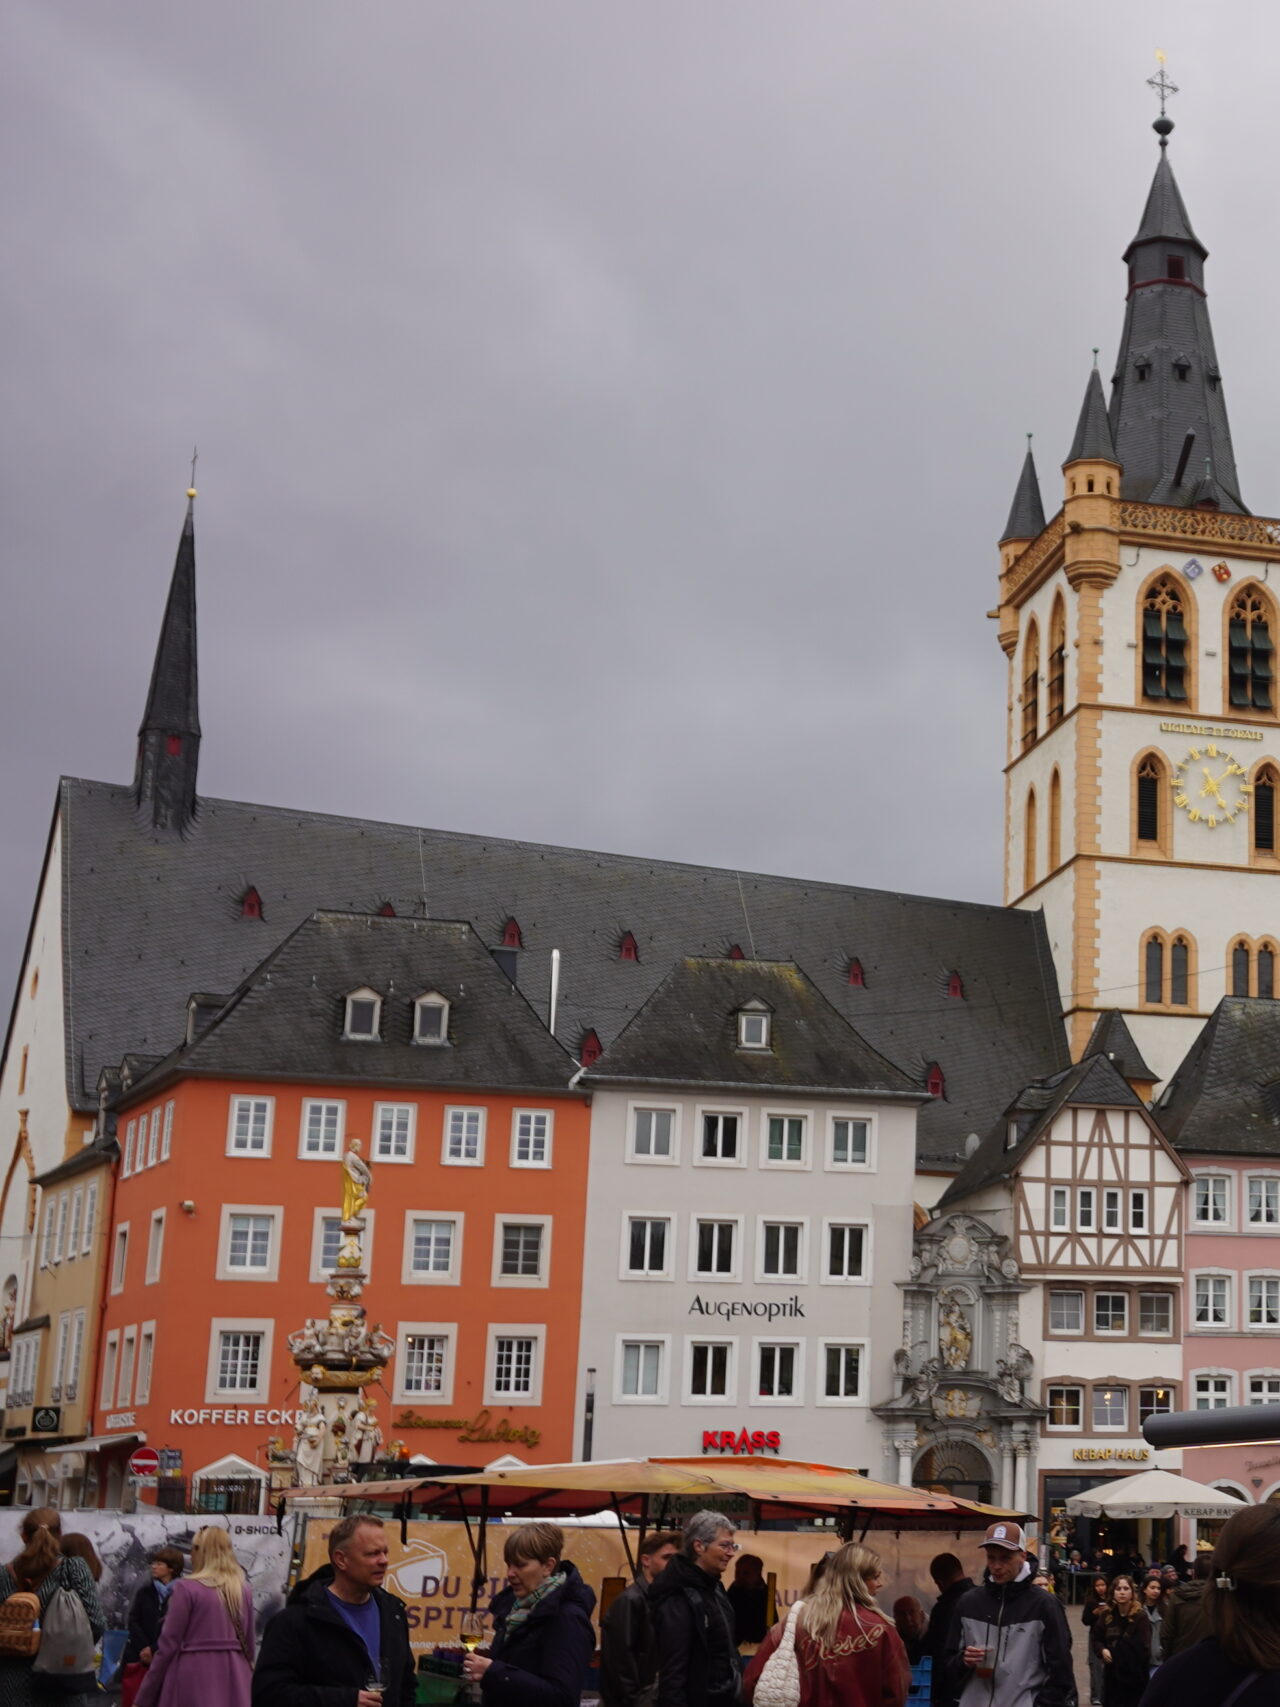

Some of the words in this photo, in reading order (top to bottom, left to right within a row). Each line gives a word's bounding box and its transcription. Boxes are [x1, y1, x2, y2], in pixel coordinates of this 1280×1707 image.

[169, 1409, 249, 1425] KOFFER
[703, 1426, 780, 1455] KRASS
[1073, 1448, 1112, 1461] KEBAP
[1115, 1448, 1150, 1461] HAUS
[1183, 1508, 1214, 1517] KEBAP
[421, 1576, 461, 1598] DU
